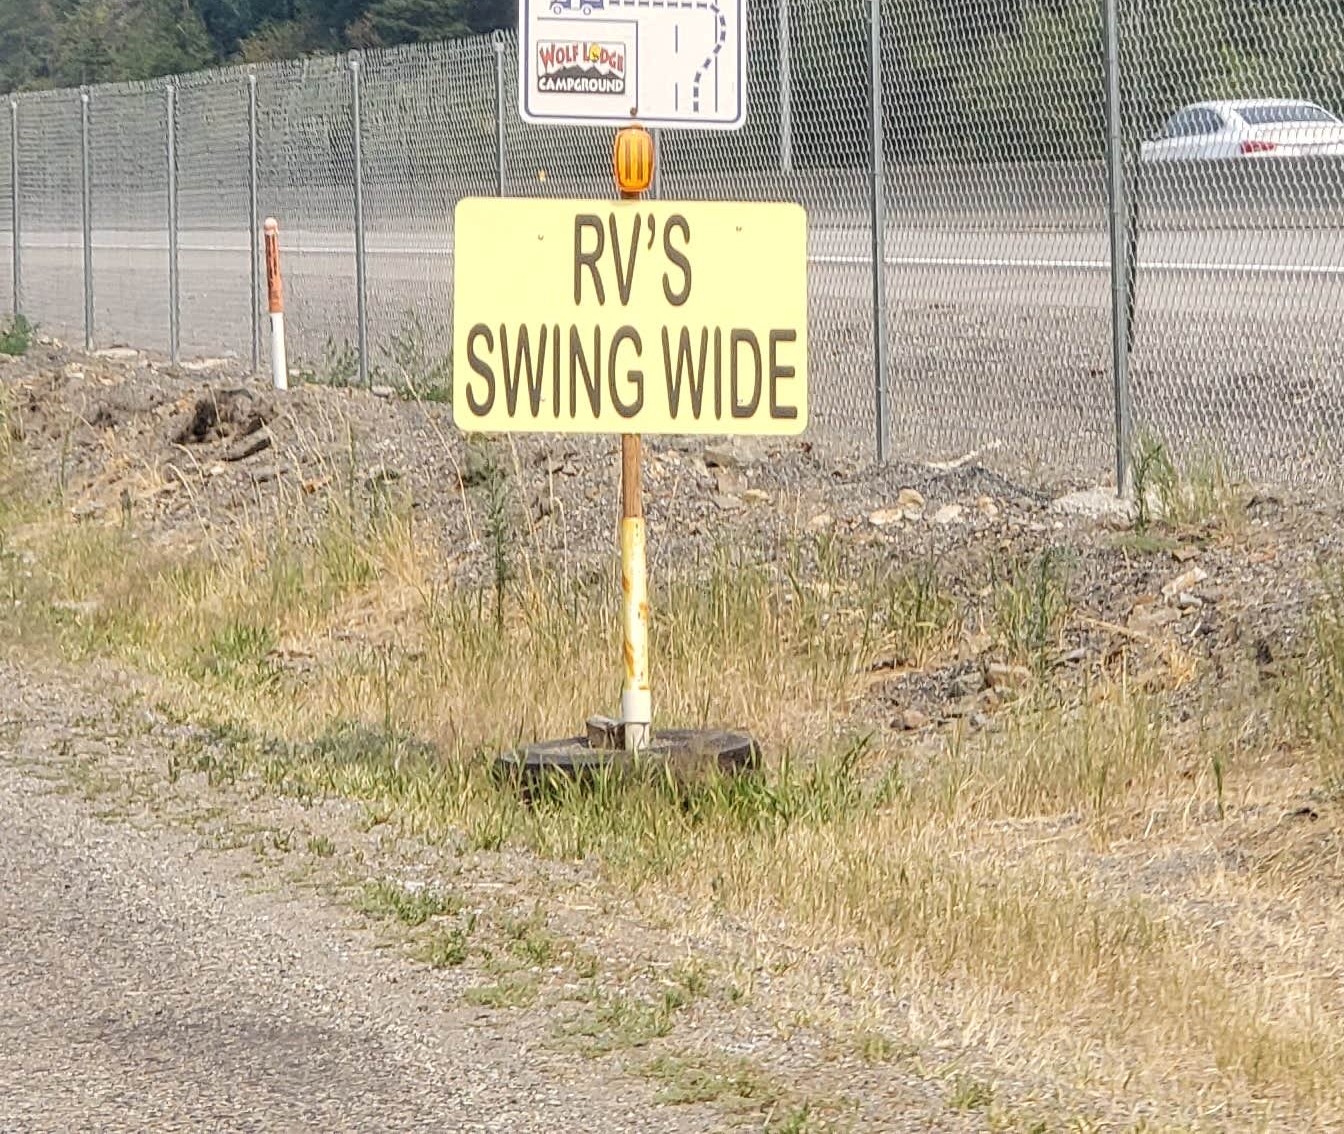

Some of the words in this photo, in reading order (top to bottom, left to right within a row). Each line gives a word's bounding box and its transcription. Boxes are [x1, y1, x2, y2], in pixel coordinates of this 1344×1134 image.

[538, 76, 624, 92] CAMPGROUND
[539, 41, 578, 69] WOLF
[573, 212, 692, 306] RV'S
[465, 322, 644, 418] SWING
[661, 325, 798, 420] WIDE
